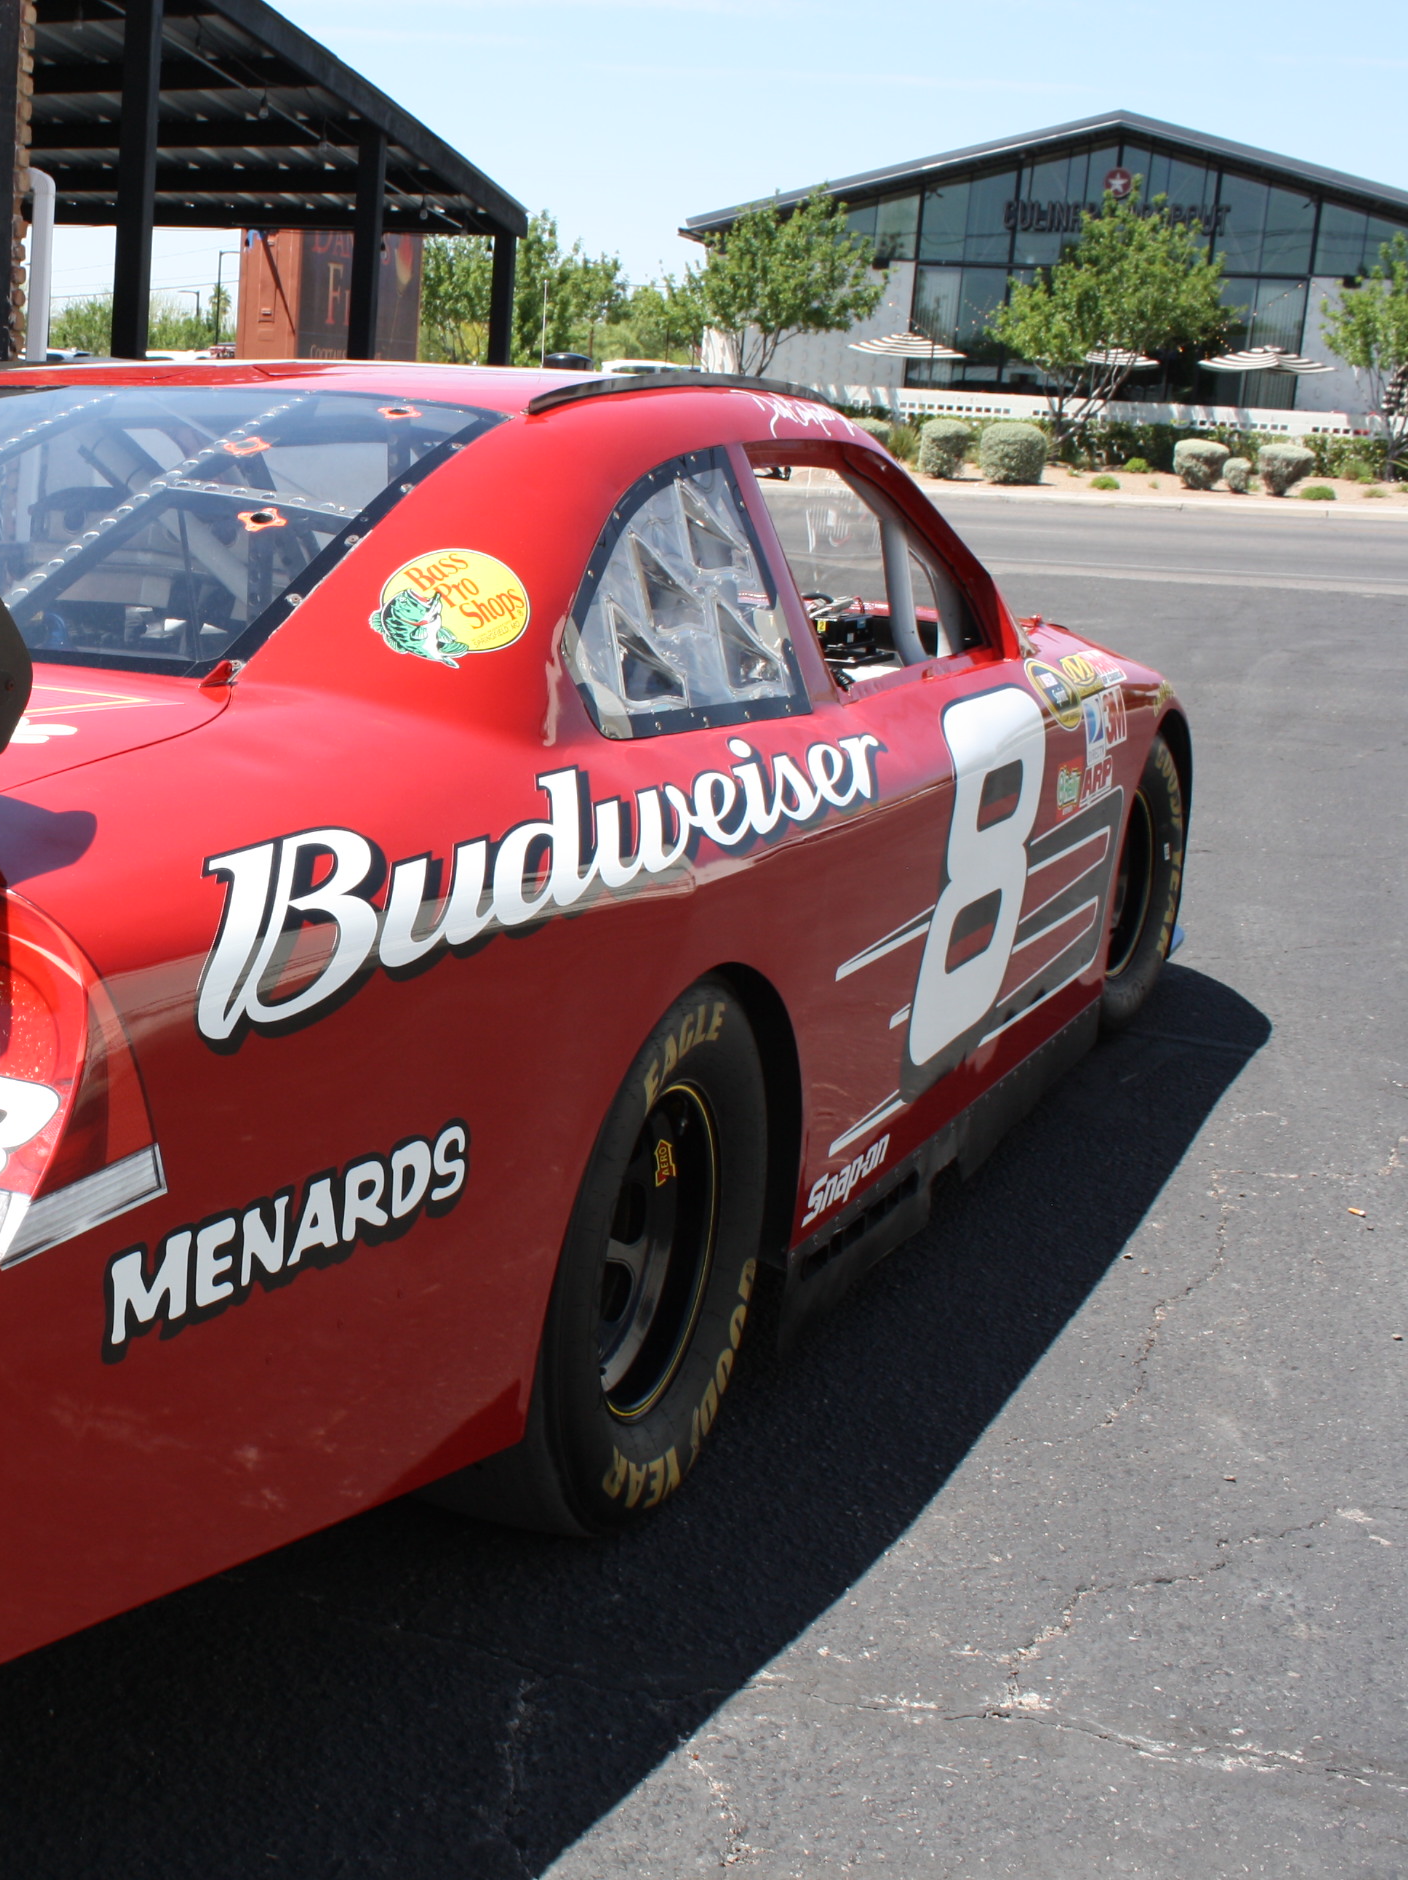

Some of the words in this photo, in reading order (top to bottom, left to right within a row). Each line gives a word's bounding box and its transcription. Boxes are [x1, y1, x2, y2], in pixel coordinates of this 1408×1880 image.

[404, 553, 469, 592] Bass
[430, 578, 480, 609] Pro
[459, 588, 525, 630] Shops
[1101, 689, 1125, 746] 3M
[1080, 757, 1112, 804] ARP
[194, 732, 882, 1044] Budweiser
[908, 686, 1047, 1067] 8
[644, 1001, 726, 1115] EAGLE
[658, 1146, 671, 1176] AERO
[800, 1132, 891, 1229] Snap-on
[107, 1122, 469, 1350] MENARDS
[601, 1444, 683, 1510] YEAR
